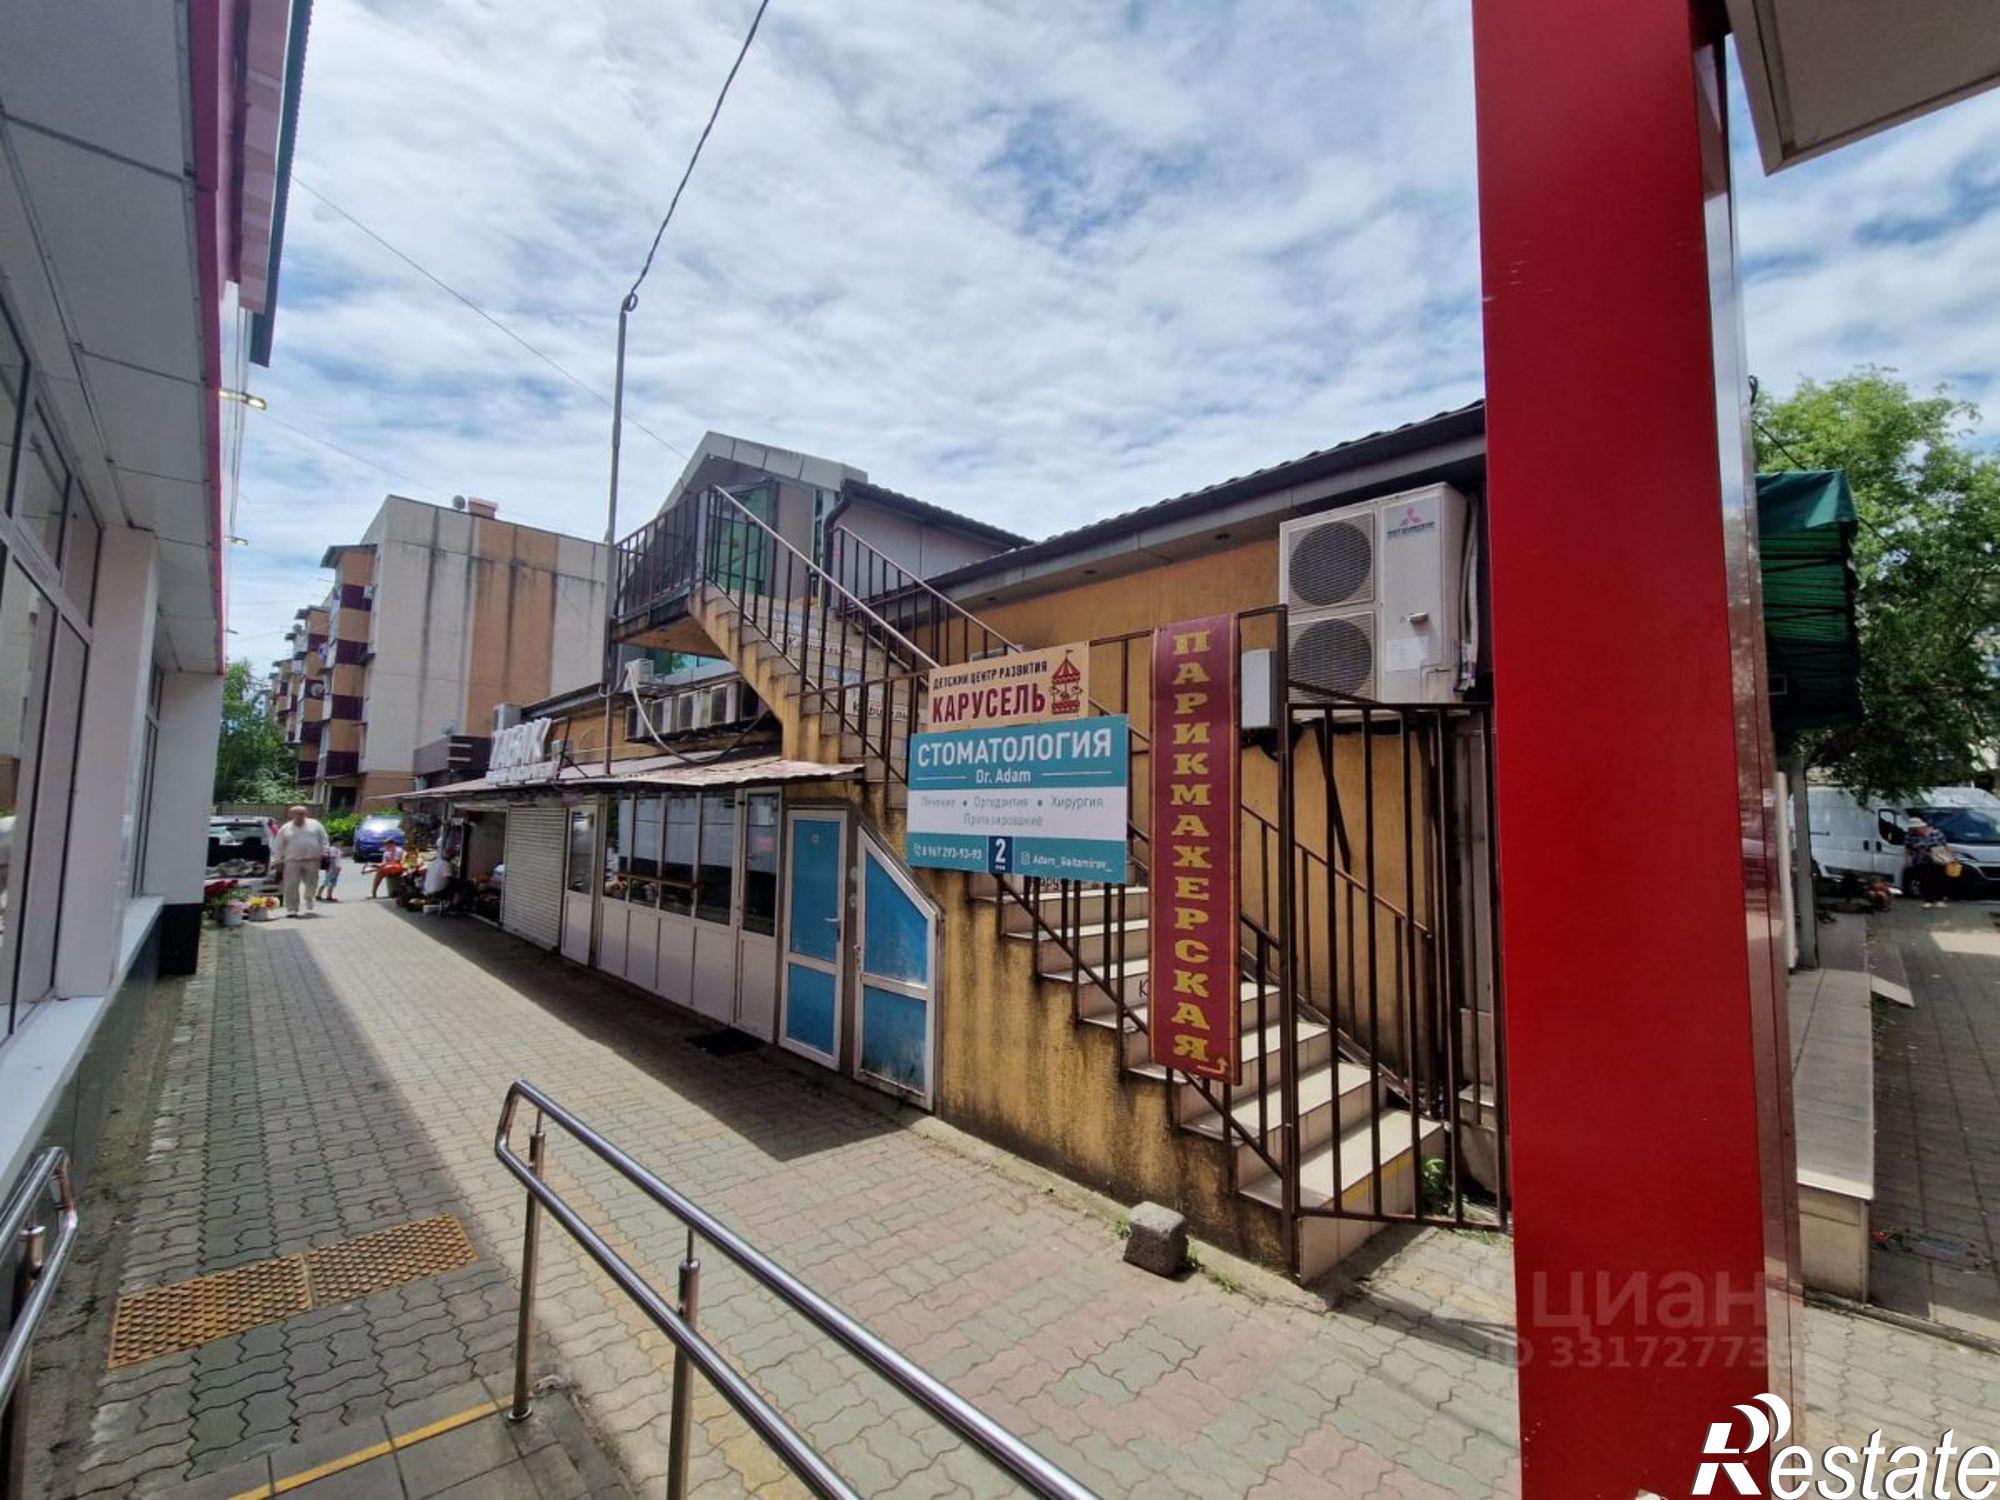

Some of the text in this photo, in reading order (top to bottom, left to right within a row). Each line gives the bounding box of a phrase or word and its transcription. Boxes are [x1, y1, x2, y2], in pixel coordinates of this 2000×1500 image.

[971, 668, 998, 685] ЦЕНТР
[999, 660, 1048, 679] РАЗВИТИЯ
[932, 683, 1046, 723] КАРУСЕЛЬ
[917, 728, 1113, 767] СТОМАТОЛОГИЯ
[976, 768, 1031, 784] Dr. Adam
[1051, 795, 1104, 810] Хирургия
[995, 838, 1006, 863] 2
[1170, 629, 1213, 1063] ПАРИКМАХЕРСКАЯ
